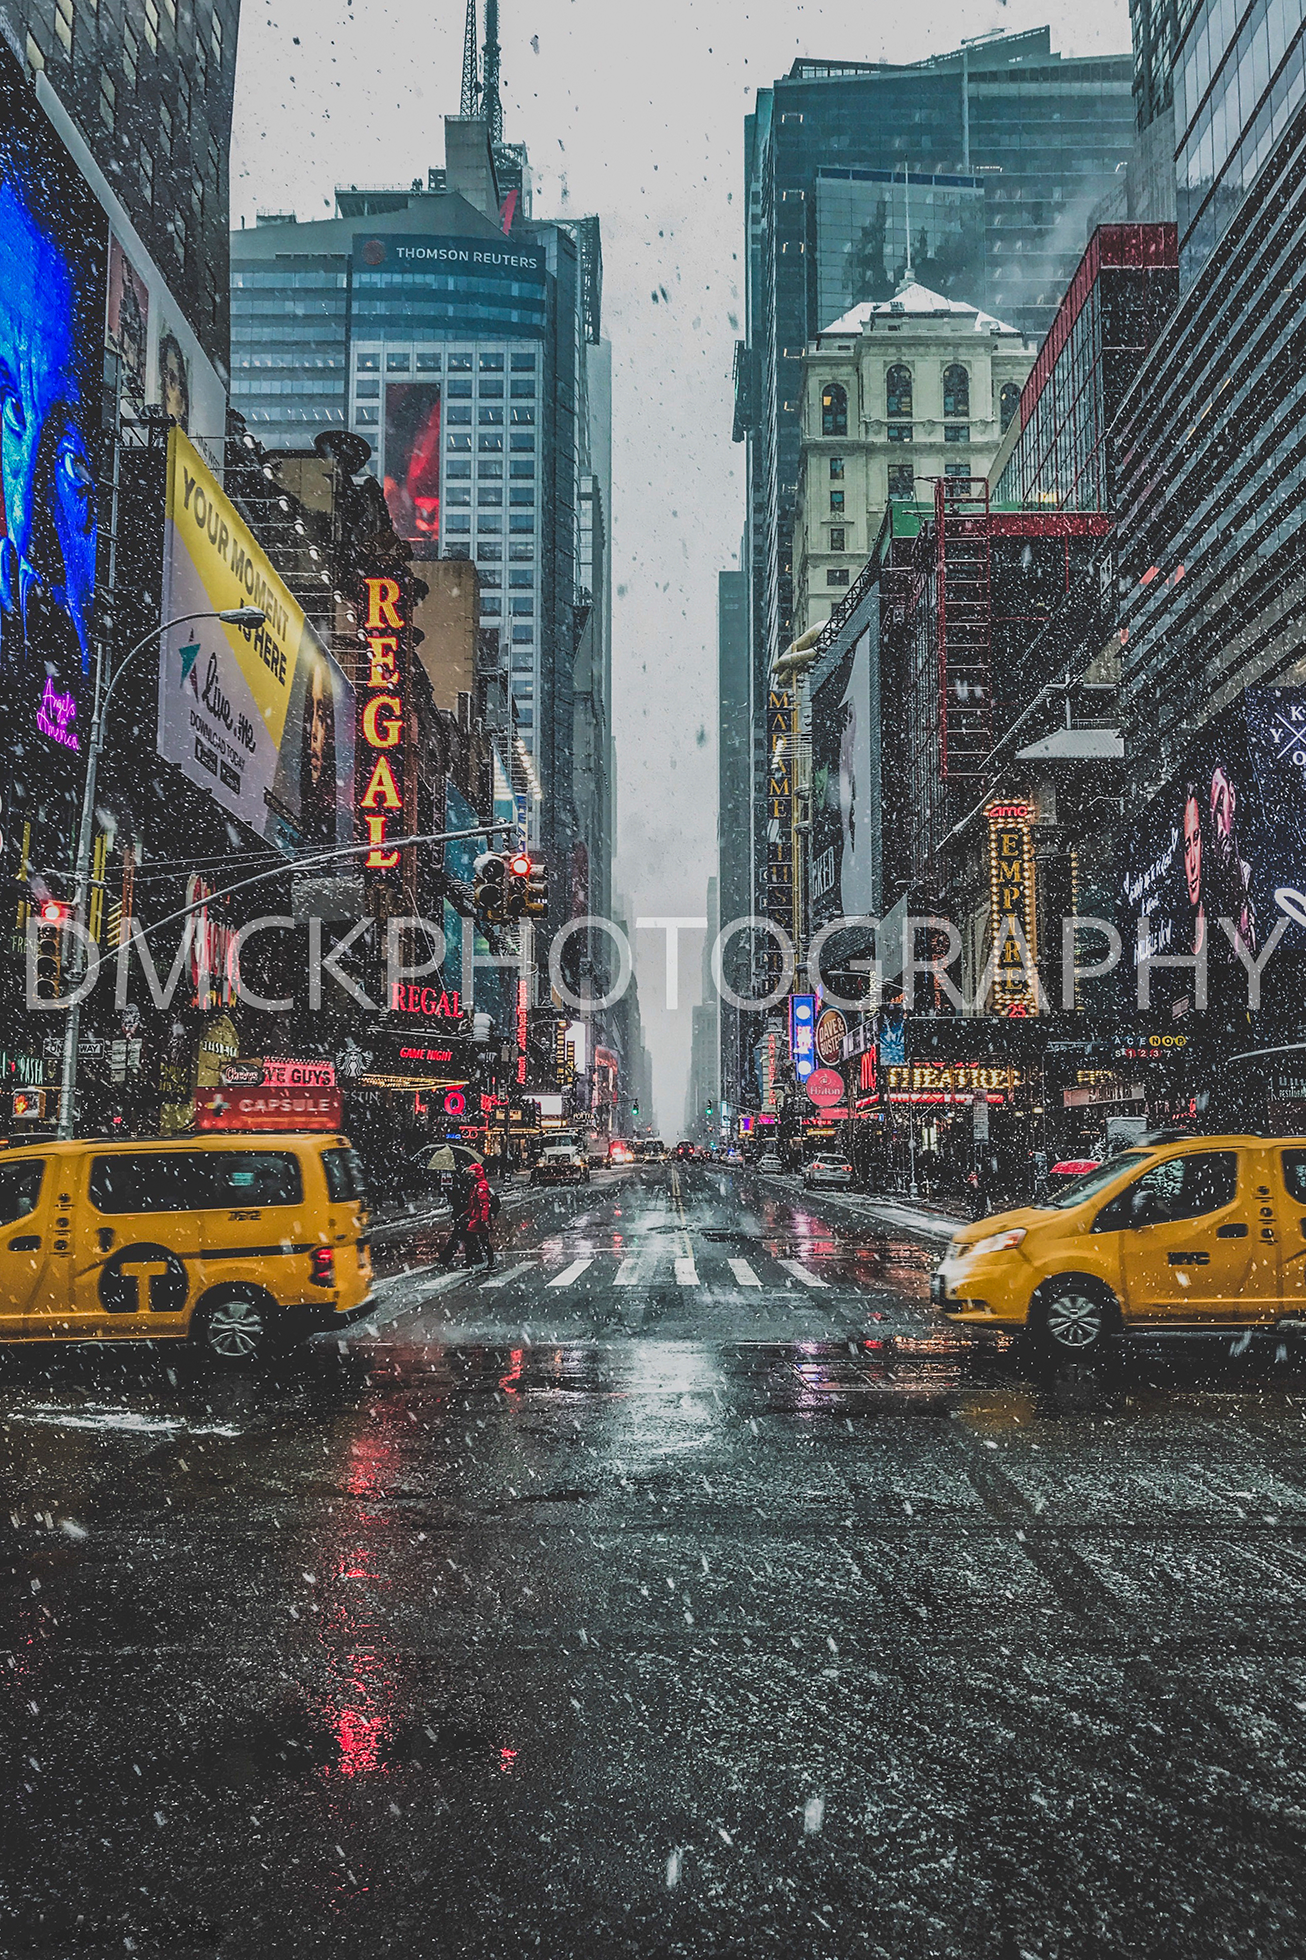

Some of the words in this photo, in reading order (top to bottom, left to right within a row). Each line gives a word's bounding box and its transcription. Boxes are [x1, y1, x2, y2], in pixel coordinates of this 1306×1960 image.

[396, 247, 469, 261] THOMSON
[473, 251, 538, 269] REUTERS
[183, 465, 229, 562] YOUR
[230, 538, 289, 642] MOMENT
[254, 626, 288, 687] HERE
[37, 706, 81, 750] America
[360, 577, 404, 868] REGAL
[190, 709, 226, 755] DOWNLOAD
[226, 744, 246, 773] TODAY
[768, 691, 790, 818] MADAME
[989, 805, 1028, 818] amc
[1000, 833, 1023, 990] EMPIRE
[390, 982, 464, 1019] REGAL
[1006, 1003, 1027, 1019] 25
[819, 1018, 838, 1042] DAVE
[837, 1017, 845, 1032] &
[400, 1047, 425, 1061] GAME
[426, 1048, 453, 1062] NIGHT
[291, 1068, 331, 1086] GUYS
[343, 1091, 379, 1101] ESTIN
[810, 1086, 841, 1096] Hilton
[239, 1098, 331, 1112] CAPSULE
